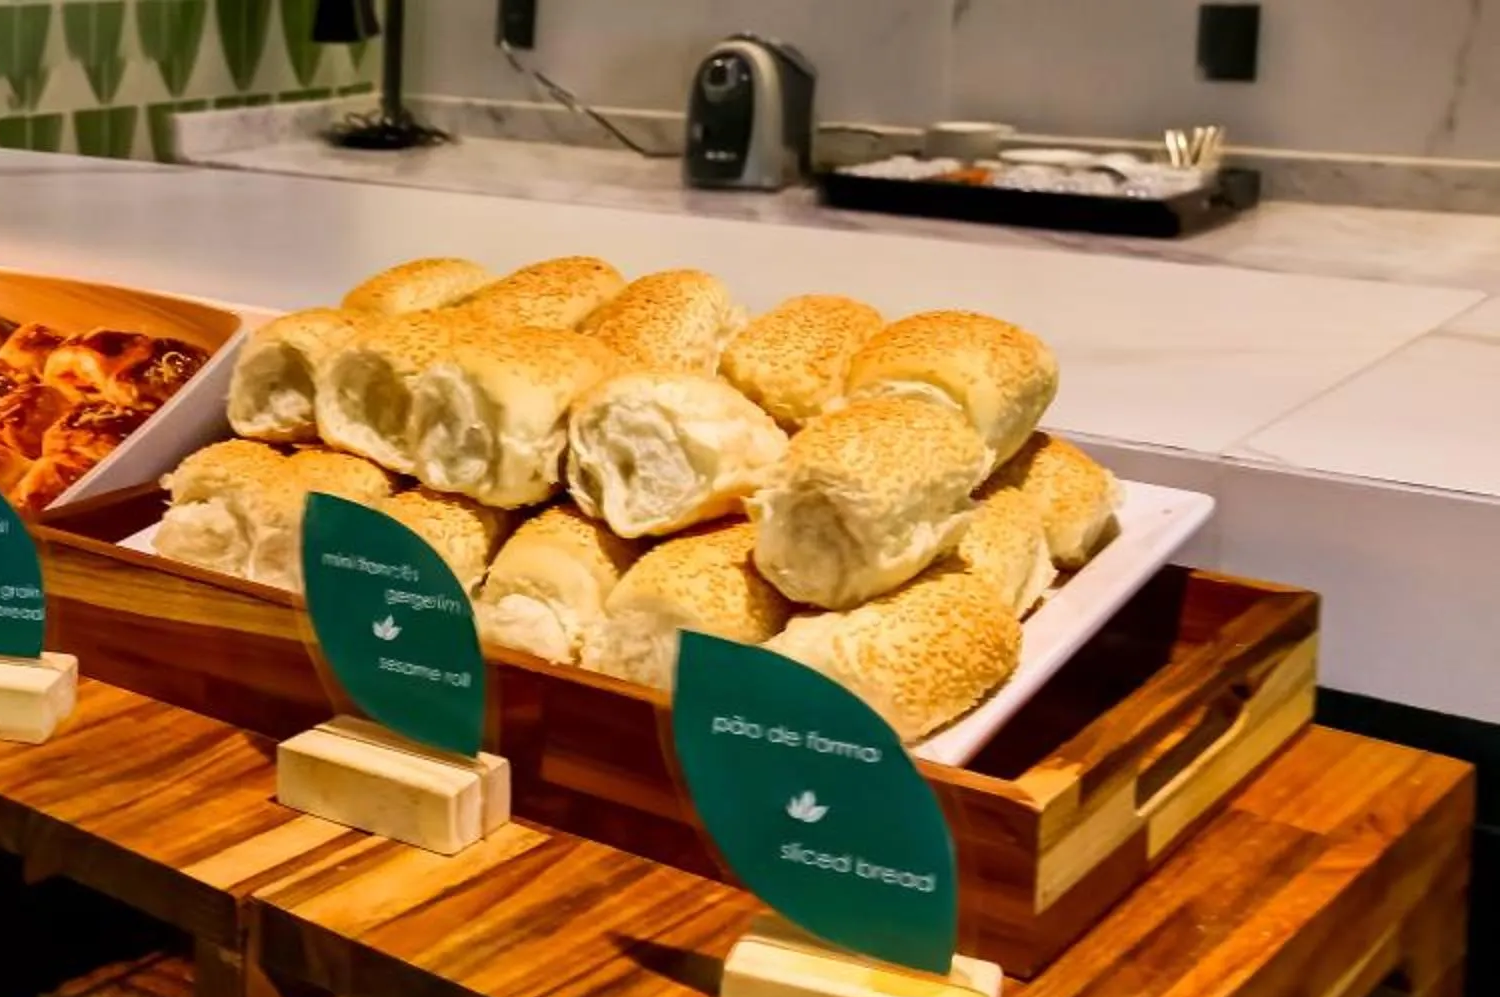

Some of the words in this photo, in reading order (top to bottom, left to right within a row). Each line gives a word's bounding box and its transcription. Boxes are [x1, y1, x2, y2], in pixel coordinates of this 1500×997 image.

[377, 656, 442, 682] sesame
[711, 715, 763, 739] pão
[767, 724, 802, 747] de
[805, 730, 883, 763] forma
[780, 842, 852, 874] sliced
[855, 858, 937, 894] bread
